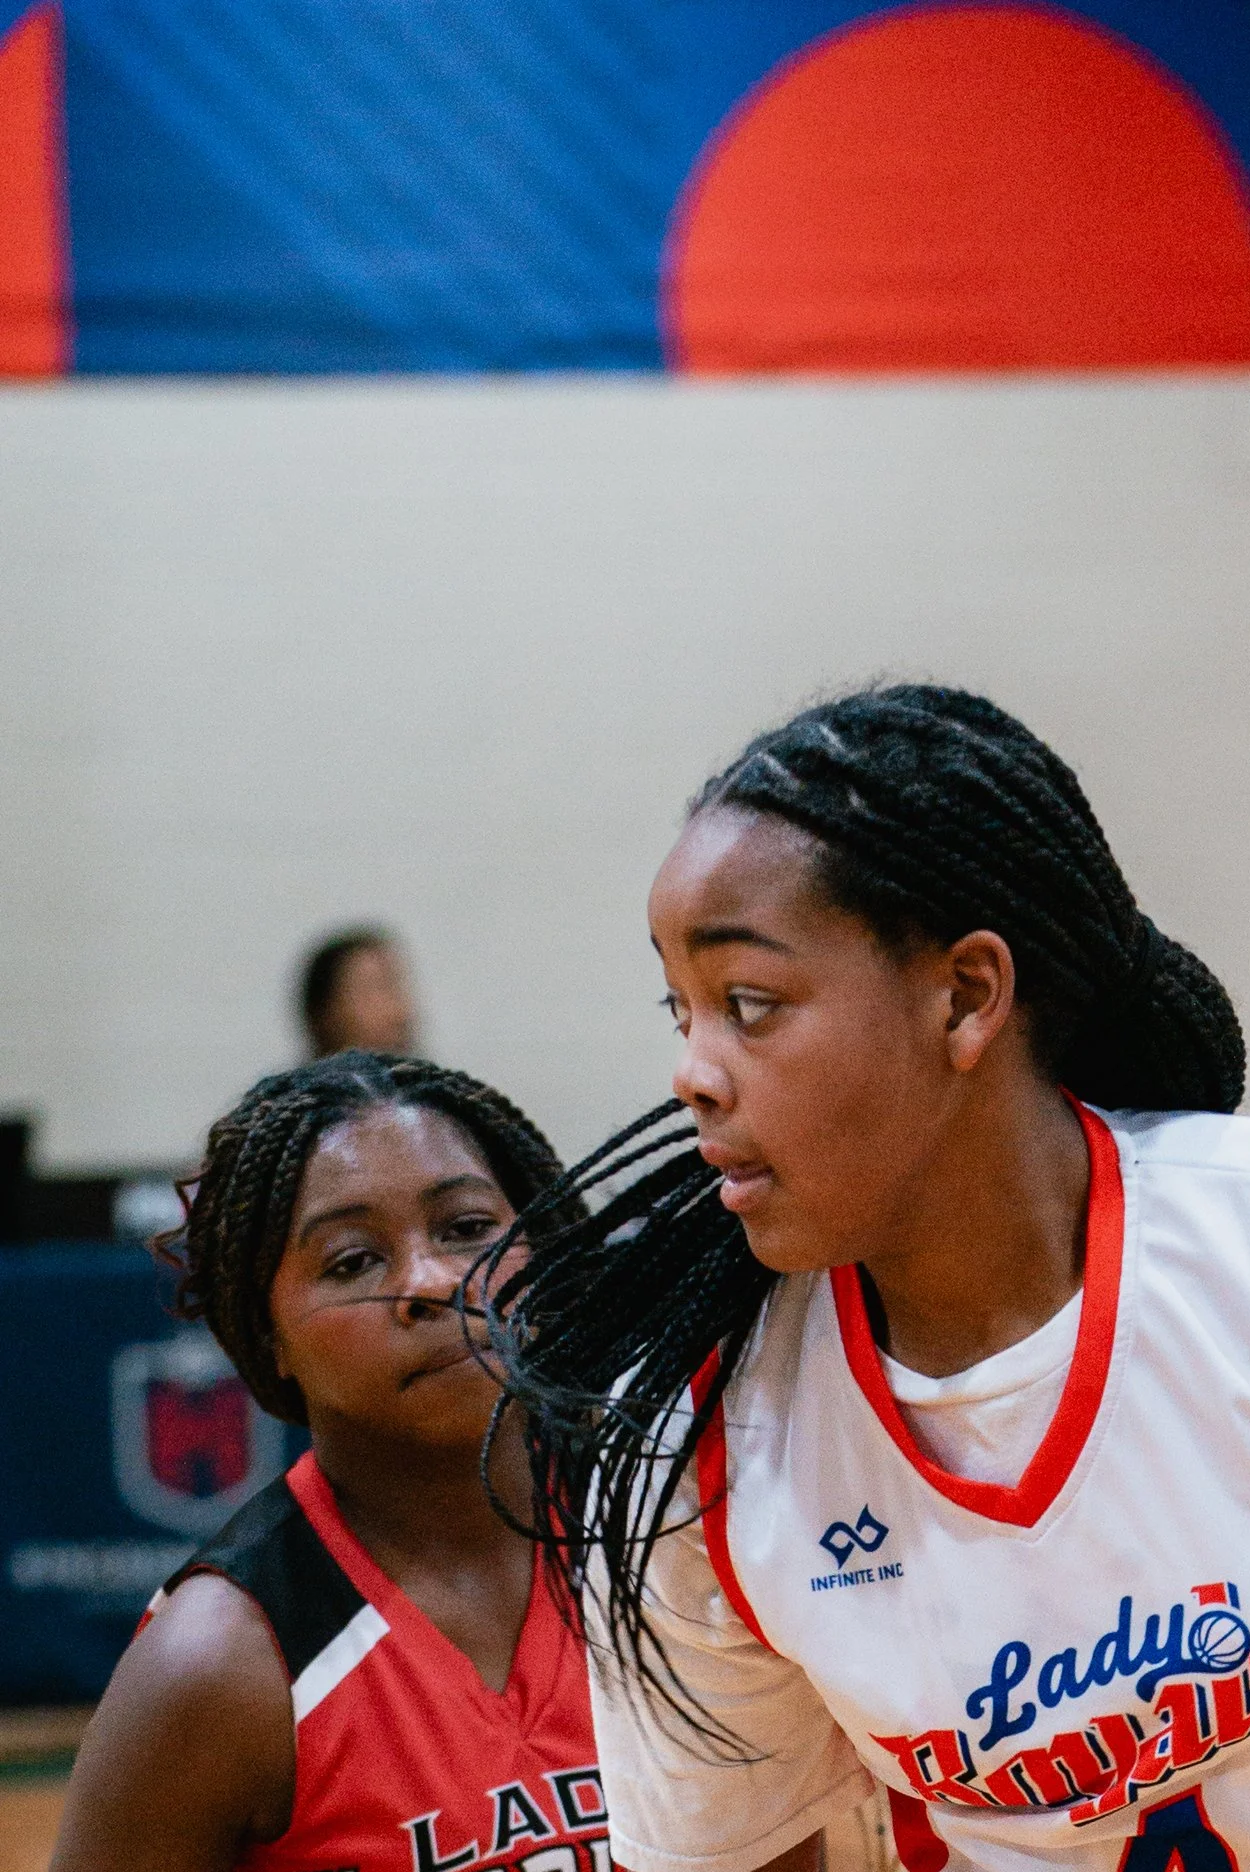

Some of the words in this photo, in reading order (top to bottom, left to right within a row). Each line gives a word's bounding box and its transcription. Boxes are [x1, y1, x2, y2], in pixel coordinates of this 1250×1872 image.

[810, 1568, 876, 1592] INFINITE
[878, 1562, 904, 1582] INC
[965, 1596, 1225, 1752] Lady
